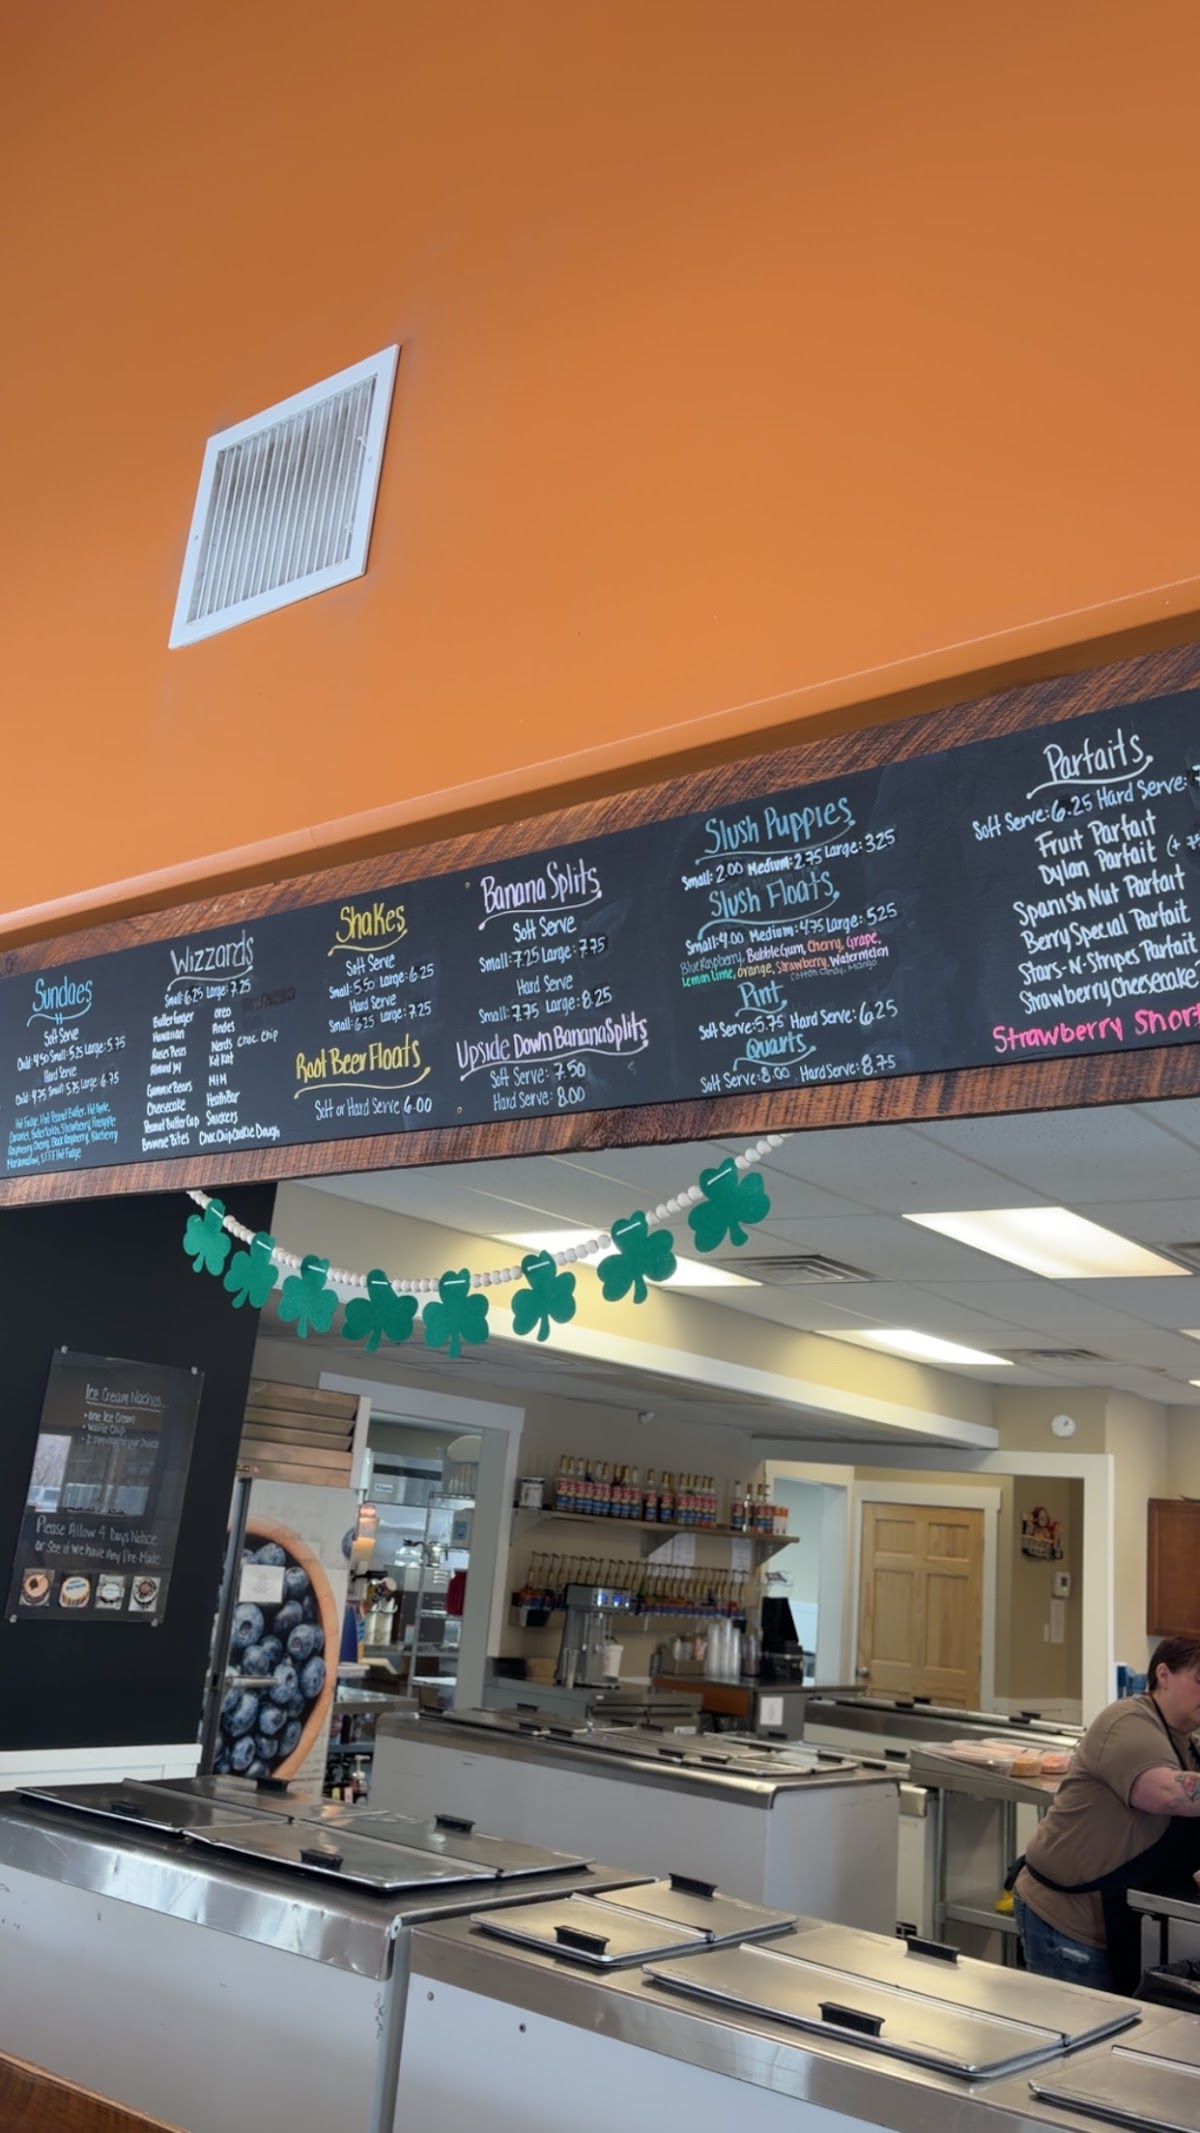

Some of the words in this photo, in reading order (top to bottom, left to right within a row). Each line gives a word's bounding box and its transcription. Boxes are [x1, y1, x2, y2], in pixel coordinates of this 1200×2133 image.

[1043, 728, 1143, 783] Parfaits
[972, 814, 1001, 841] Soft
[1004, 808, 1050, 832] Serve:
[1050, 793, 1093, 823] 6.25
[1096, 782, 1134, 810] Hard
[1137, 775, 1188, 800] Serve:
[705, 814, 760, 854] Slush
[764, 797, 853, 843] Puppies
[1035, 829, 1083, 858] Fruit
[1087, 808, 1157, 846] Parfait
[682, 869, 714, 891] Small:
[747, 856, 794, 876] Medium:
[824, 841, 863, 860] Large:
[1038, 859, 1090, 887] Dylan
[1094, 839, 1158, 872] Parfait
[480, 876, 546, 914] Banana
[547, 858, 601, 903] Splits
[709, 886, 761, 918] Slush
[766, 871, 834, 909] Floats
[1013, 891, 1087, 928] Spanish
[1087, 883, 1120, 908] Nut
[1123, 863, 1186, 898] Parfait
[336, 903, 406, 943] Shakes
[513, 918, 537, 943] Soft
[539, 915, 577, 938] Serve
[685, 938, 719, 956] Small:
[749, 925, 800, 943] Medium:
[826, 915, 863, 933] Large:
[1020, 928, 1071, 954] Berry
[1069, 912, 1128, 948] Special
[1128, 898, 1191, 931] Parfait
[170, 928, 254, 975] Wizzards
[479, 952, 512, 973] Small:
[541, 944, 577, 964] Large:
[1139, 931, 1198, 961] Parfait
[346, 957, 365, 977] Soft
[367, 953, 395, 972] Serve
[682, 971, 711, 987] Lemon
[830, 946, 889, 967] Watermelon
[33, 976, 93, 1012] Sundaes
[329, 983, 353, 999] Small:
[379, 971, 409, 988] Large:
[516, 974, 541, 996] Hard
[544, 974, 574, 993] Serve
[738, 980, 783, 1009] Pint
[1019, 980, 1112, 1015] Strawberry
[1111, 966, 1199, 998] Cheesecake
[350, 998, 369, 1013] Hard
[371, 993, 397, 1010] Serve
[380, 1007, 407, 1023] Large:
[479, 1006, 510, 1024] Small:
[546, 997, 581, 1016] Large:
[212, 1021, 235, 1034] Andes
[699, 1022, 718, 1041] Soft
[721, 1020, 756, 1038] Serve:
[790, 1014, 819, 1030] Hard
[821, 1008, 858, 1027] Serve:
[993, 1014, 1124, 1053] Strawberry
[211, 1038, 233, 1052] Nerds
[296, 1048, 327, 1083] Root
[329, 1047, 367, 1076] Beer
[368, 1033, 421, 1071] Floats
[456, 1033, 511, 1069] Upside
[512, 1031, 554, 1059] Down
[746, 1031, 807, 1060] Quarts
[490, 1066, 510, 1089] Soft
[513, 1067, 550, 1086] Serve:
[700, 1076, 721, 1094] Soft
[724, 1071, 761, 1089] Serve:
[800, 1065, 825, 1083] Hard
[824, 1061, 860, 1080] Serve:
[315, 1098, 334, 1121] Soft
[336, 1104, 345, 1115] or
[347, 1097, 369, 1117] Hard
[372, 1097, 401, 1115] Serve
[493, 1092, 517, 1111] Hard
[518, 1088, 554, 1108] Serve:
[36, 1514, 66, 1536] Please
